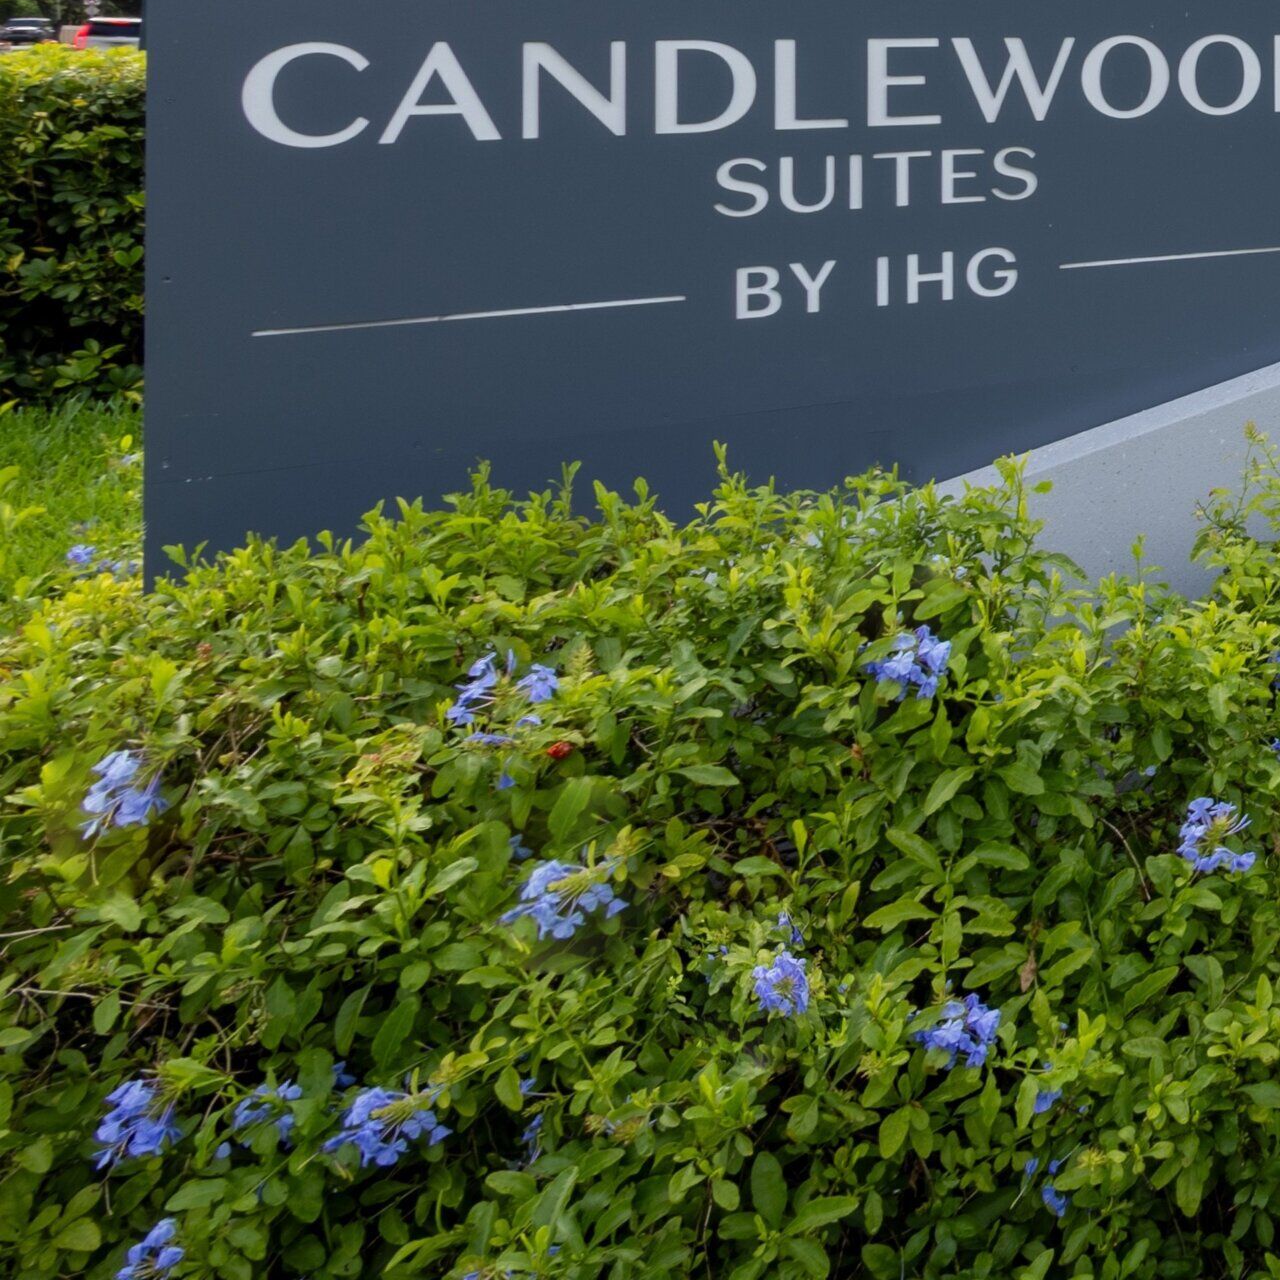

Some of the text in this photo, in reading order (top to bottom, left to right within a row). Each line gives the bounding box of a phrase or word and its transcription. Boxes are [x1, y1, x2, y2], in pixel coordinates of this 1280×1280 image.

[713, 146, 1039, 218] SUITES
[735, 247, 1018, 320] BY IHG
